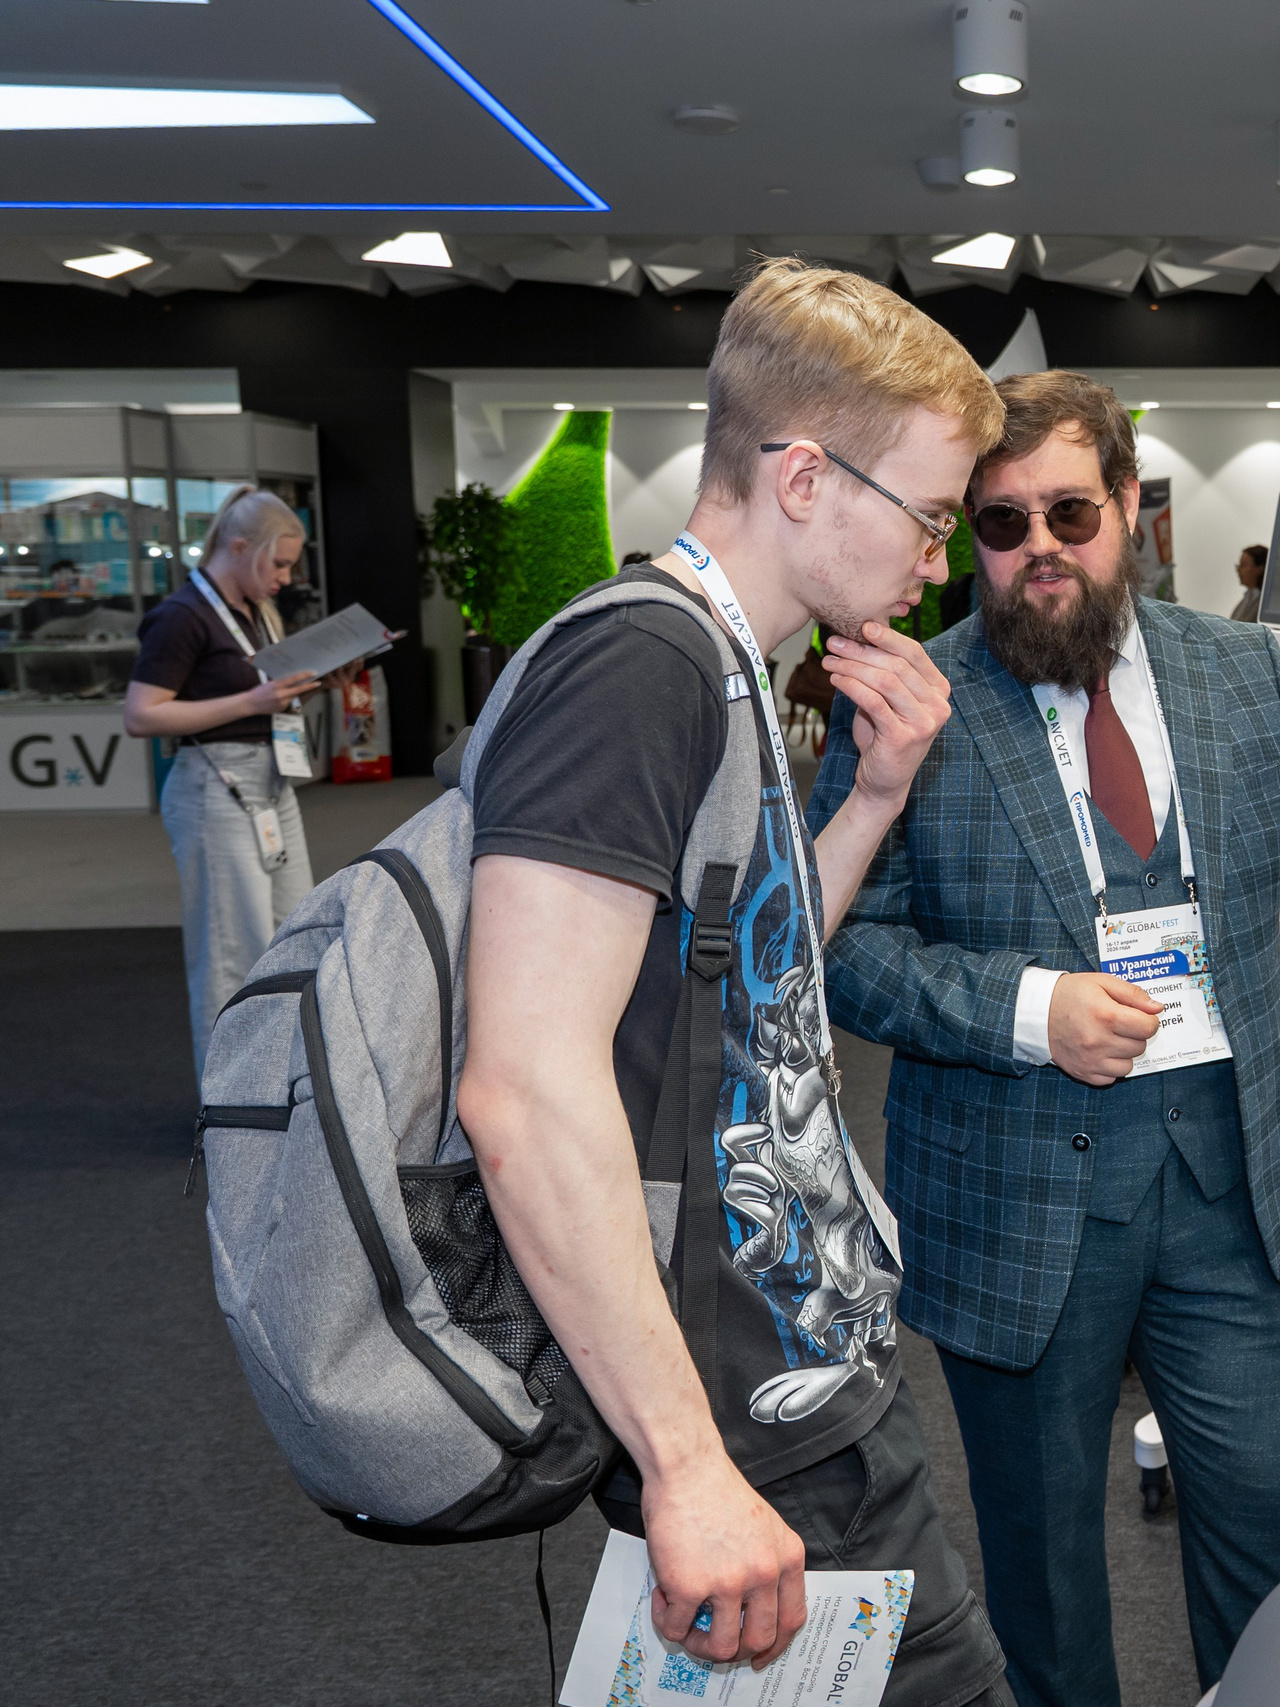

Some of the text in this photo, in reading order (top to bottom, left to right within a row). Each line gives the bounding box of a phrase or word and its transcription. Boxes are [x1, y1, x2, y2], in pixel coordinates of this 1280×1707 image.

[1050, 721, 1073, 768] AVC.VET
[11, 734, 120, 790] G V
[1126, 918, 1178, 934] GLOBAL FEST
[1108, 953, 1176, 973] III Уральский
[1143, 983, 1183, 995] КСПОНЕНТ
[1163, 1000, 1182, 1012] рин
[1159, 1014, 1184, 1029] ергей
[833, 1596, 842, 1606] На
[824, 1608, 838, 1638] каждом
[791, 1596, 831, 1706] три интересующих Вас вопрос
[798, 1634, 810, 1657] печать
[816, 1639, 828, 1664] стенде
[770, 1668, 783, 1697] лототрон
[826, 1640, 858, 1701] GLOBAL
[757, 1666, 773, 1706] на Церемон
